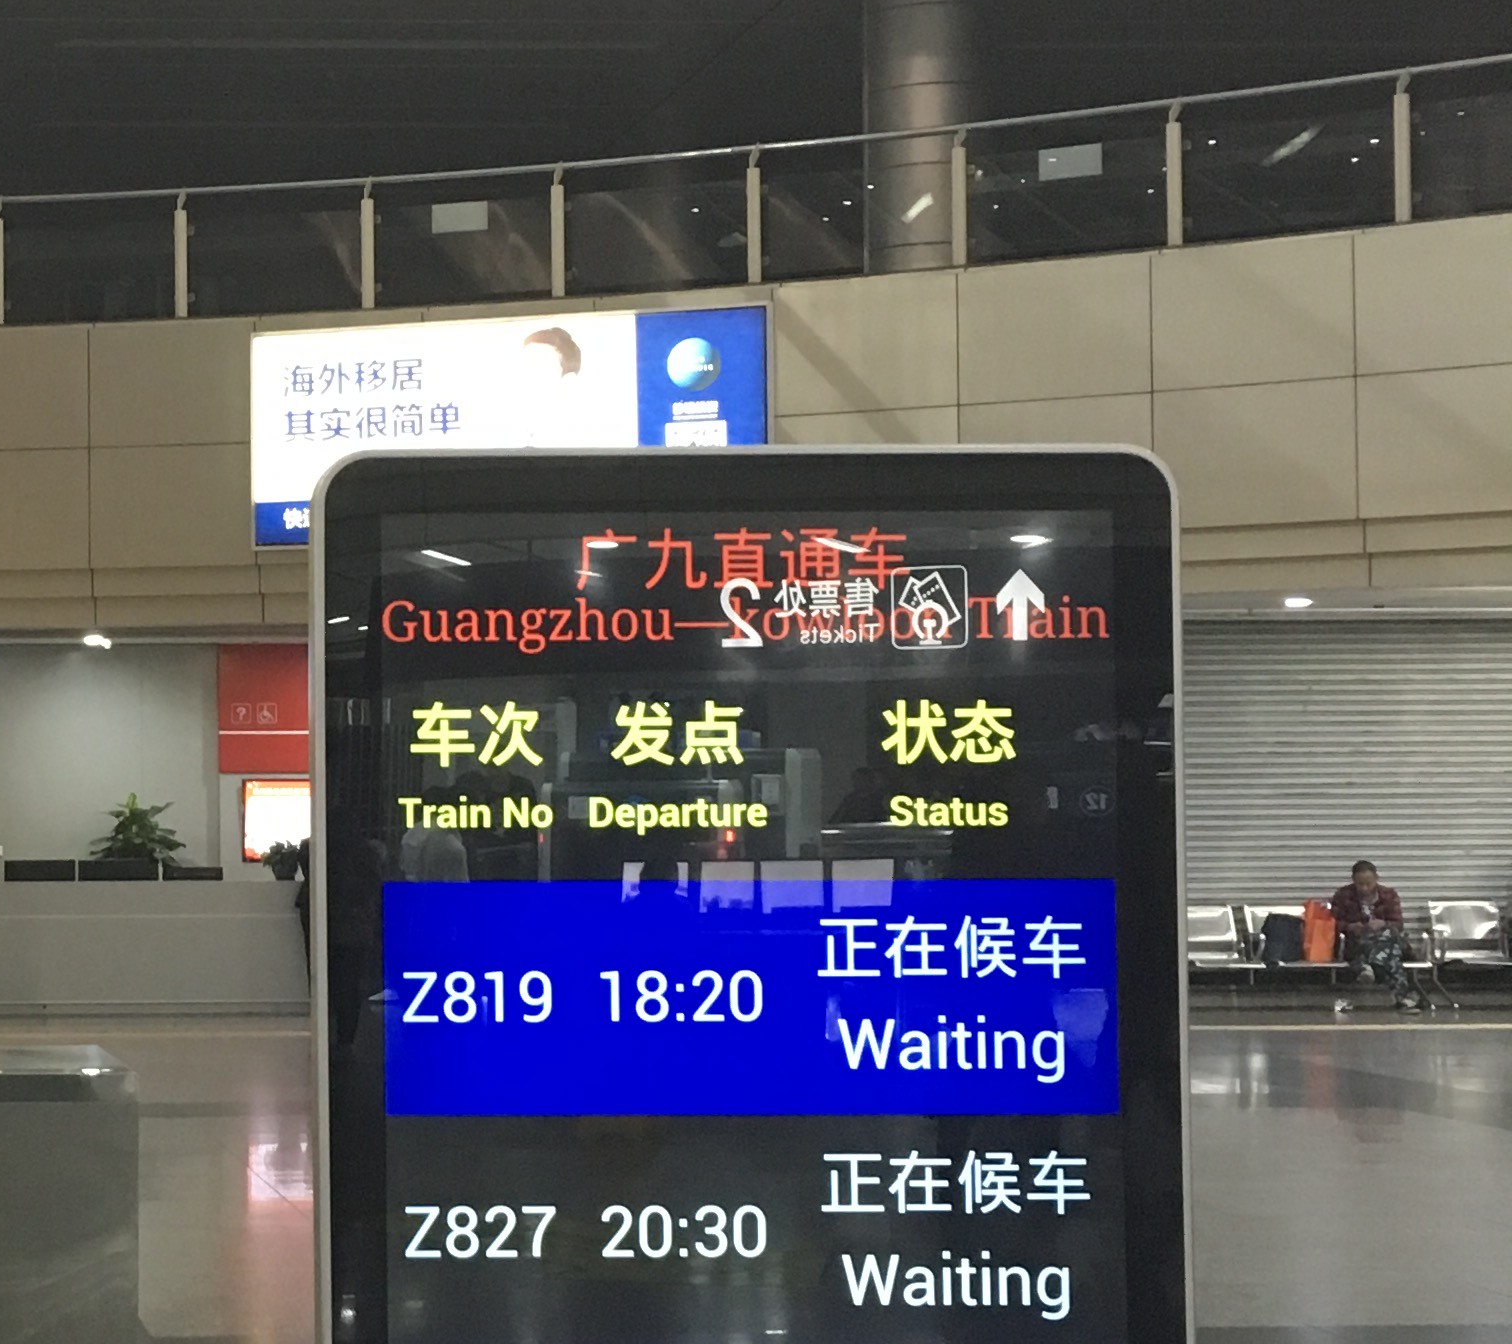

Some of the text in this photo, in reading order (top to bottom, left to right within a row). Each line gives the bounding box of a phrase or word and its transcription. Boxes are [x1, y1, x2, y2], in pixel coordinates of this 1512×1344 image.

[283, 358, 423, 397] 海外移居
[284, 402, 461, 443] 其实很简单
[576, 527, 910, 590] 广九直通车
[410, 699, 1017, 768] 车次 发点 状态
[398, 795, 1009, 836] Train No Departure Status
[818, 916, 1087, 979] 正在候车
[402, 970, 764, 1023] Z819 18:20
[837, 1014, 1066, 1083] Waiting
[821, 1150, 1092, 1215] 正在候车
[404, 1205, 768, 1259] Z827 20:30
[841, 1250, 1071, 1321] Waiting
